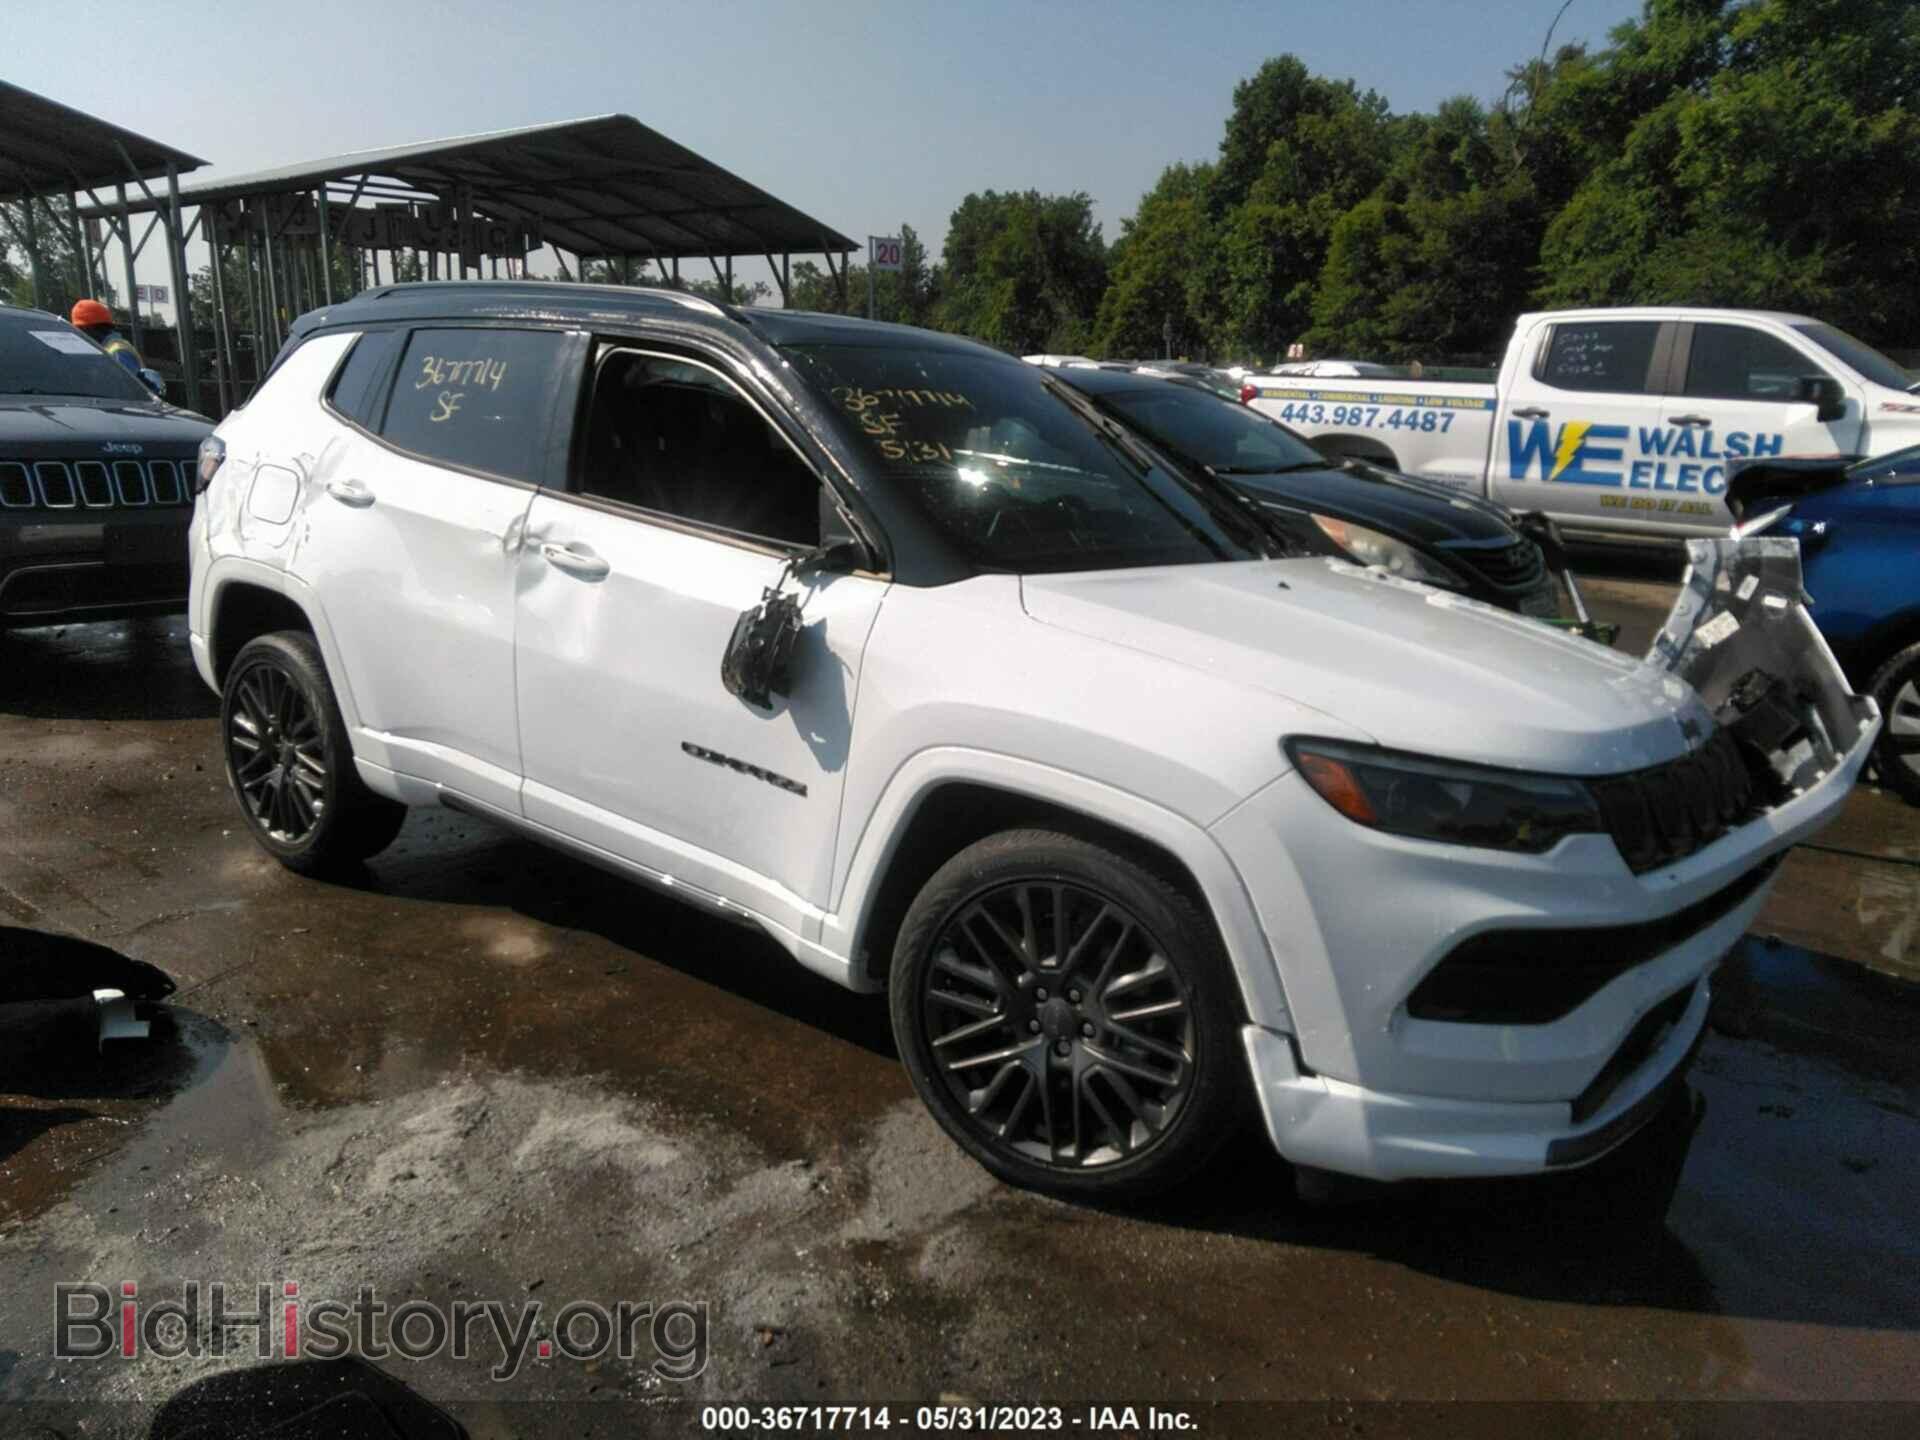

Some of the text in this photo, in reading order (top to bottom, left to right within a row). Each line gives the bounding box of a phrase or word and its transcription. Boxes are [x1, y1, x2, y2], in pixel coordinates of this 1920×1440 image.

[878, 243, 900, 265] 20
[1280, 403, 1456, 432] 443.987.4487
[1637, 426, 1785, 460] WALSH
